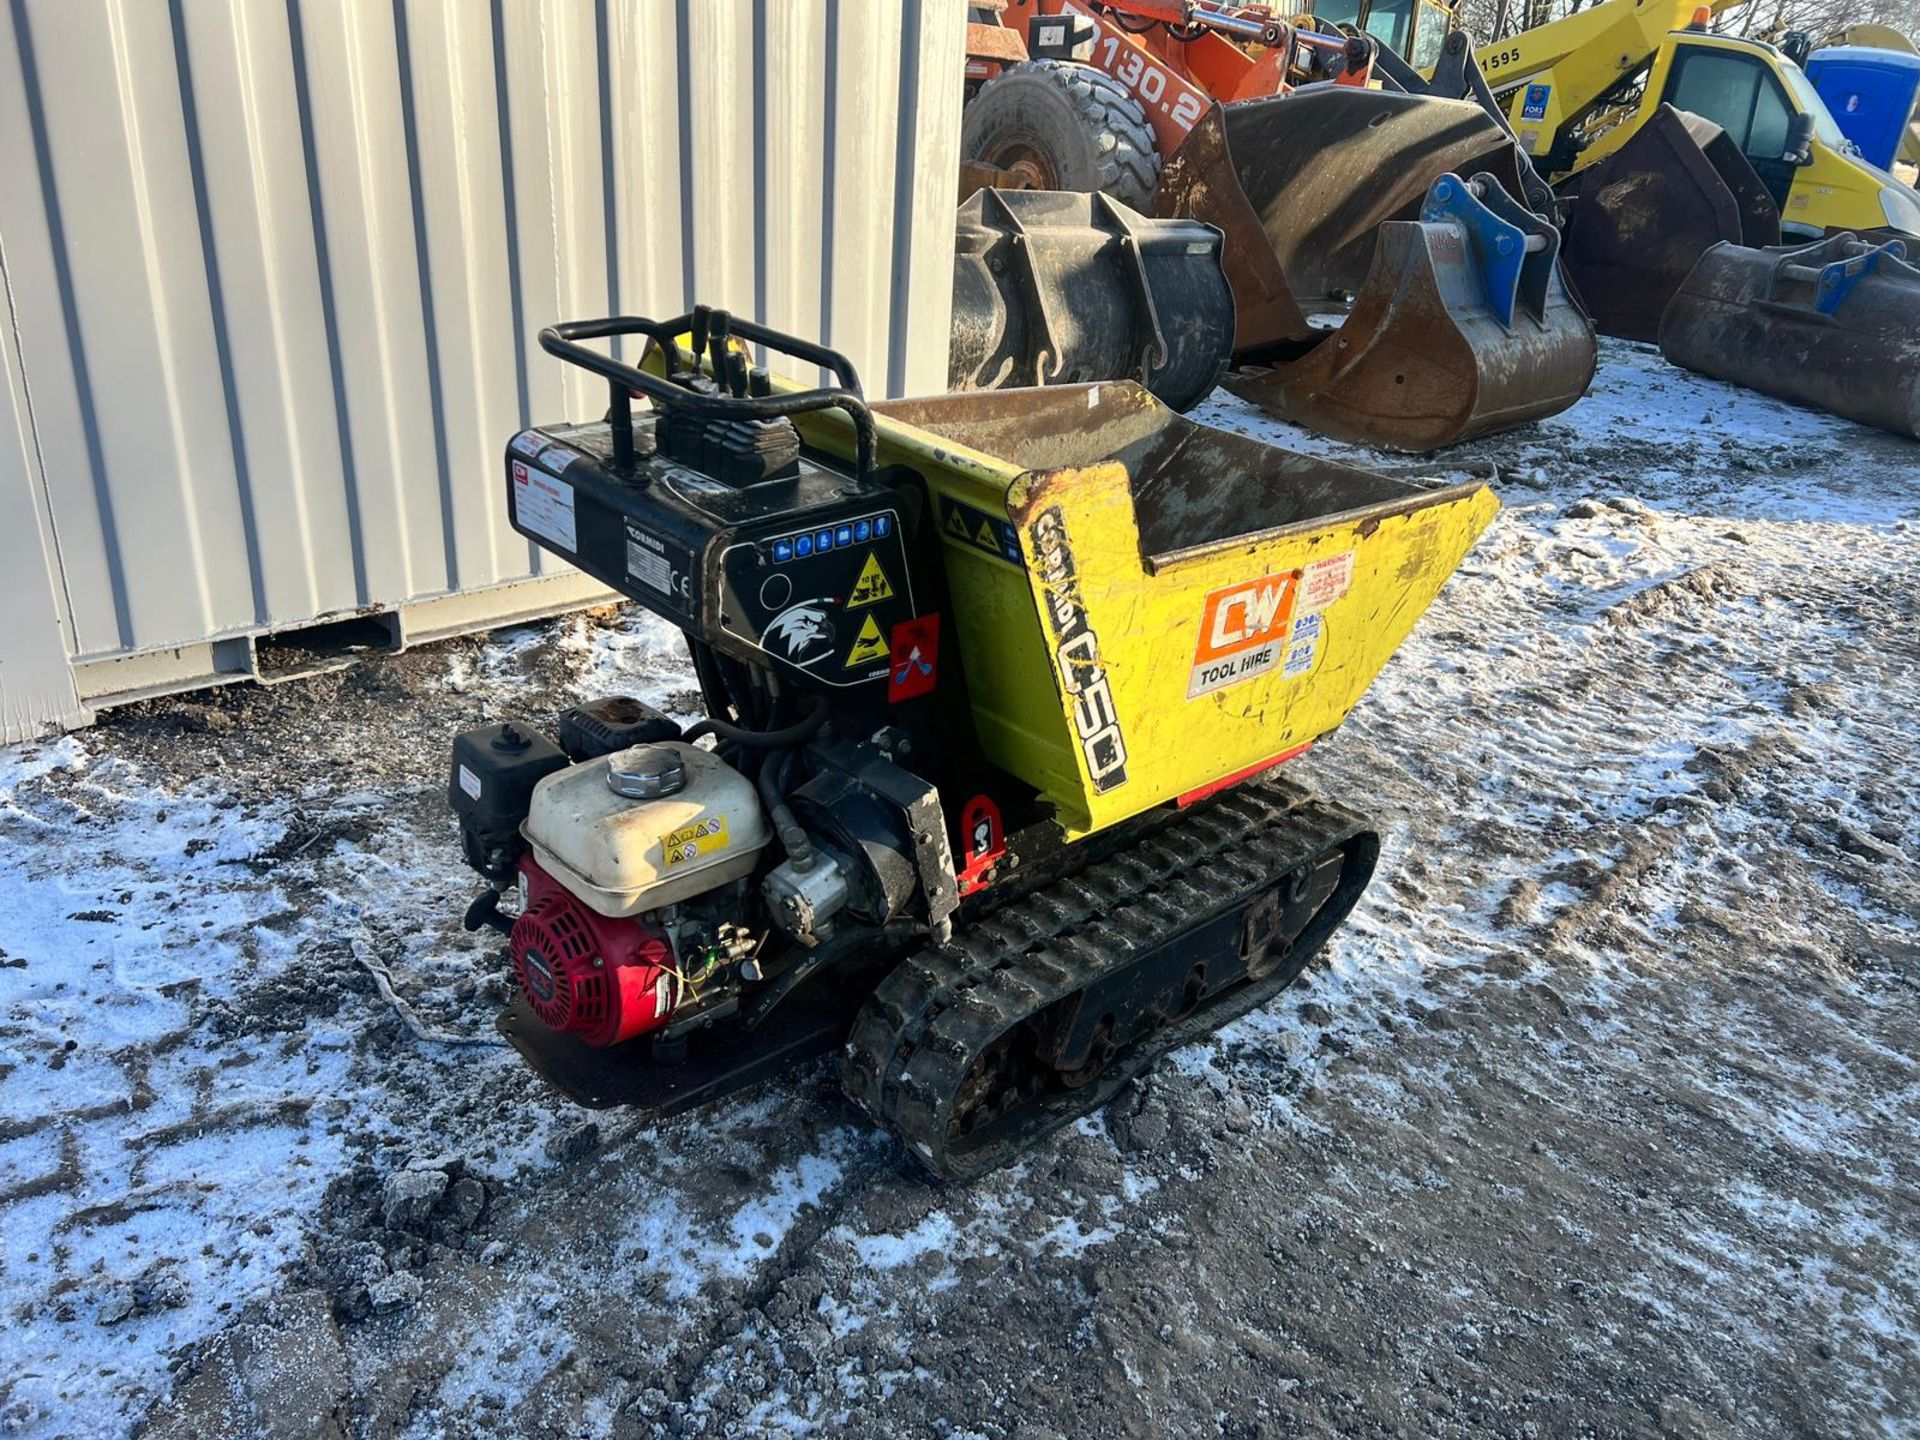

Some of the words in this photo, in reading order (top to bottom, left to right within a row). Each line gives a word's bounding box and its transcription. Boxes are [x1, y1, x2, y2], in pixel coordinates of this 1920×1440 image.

[1481, 48, 1520, 72] 1595
[1524, 105, 1544, 114] FORS
[626, 526, 665, 554] CORMIDI
[1210, 579, 1290, 649] CW
[1201, 661, 1236, 685] TOOL
[1240, 648, 1272, 673] HIRE
[1057, 630, 1127, 780] C50
[527, 953, 554, 980] HONDA
